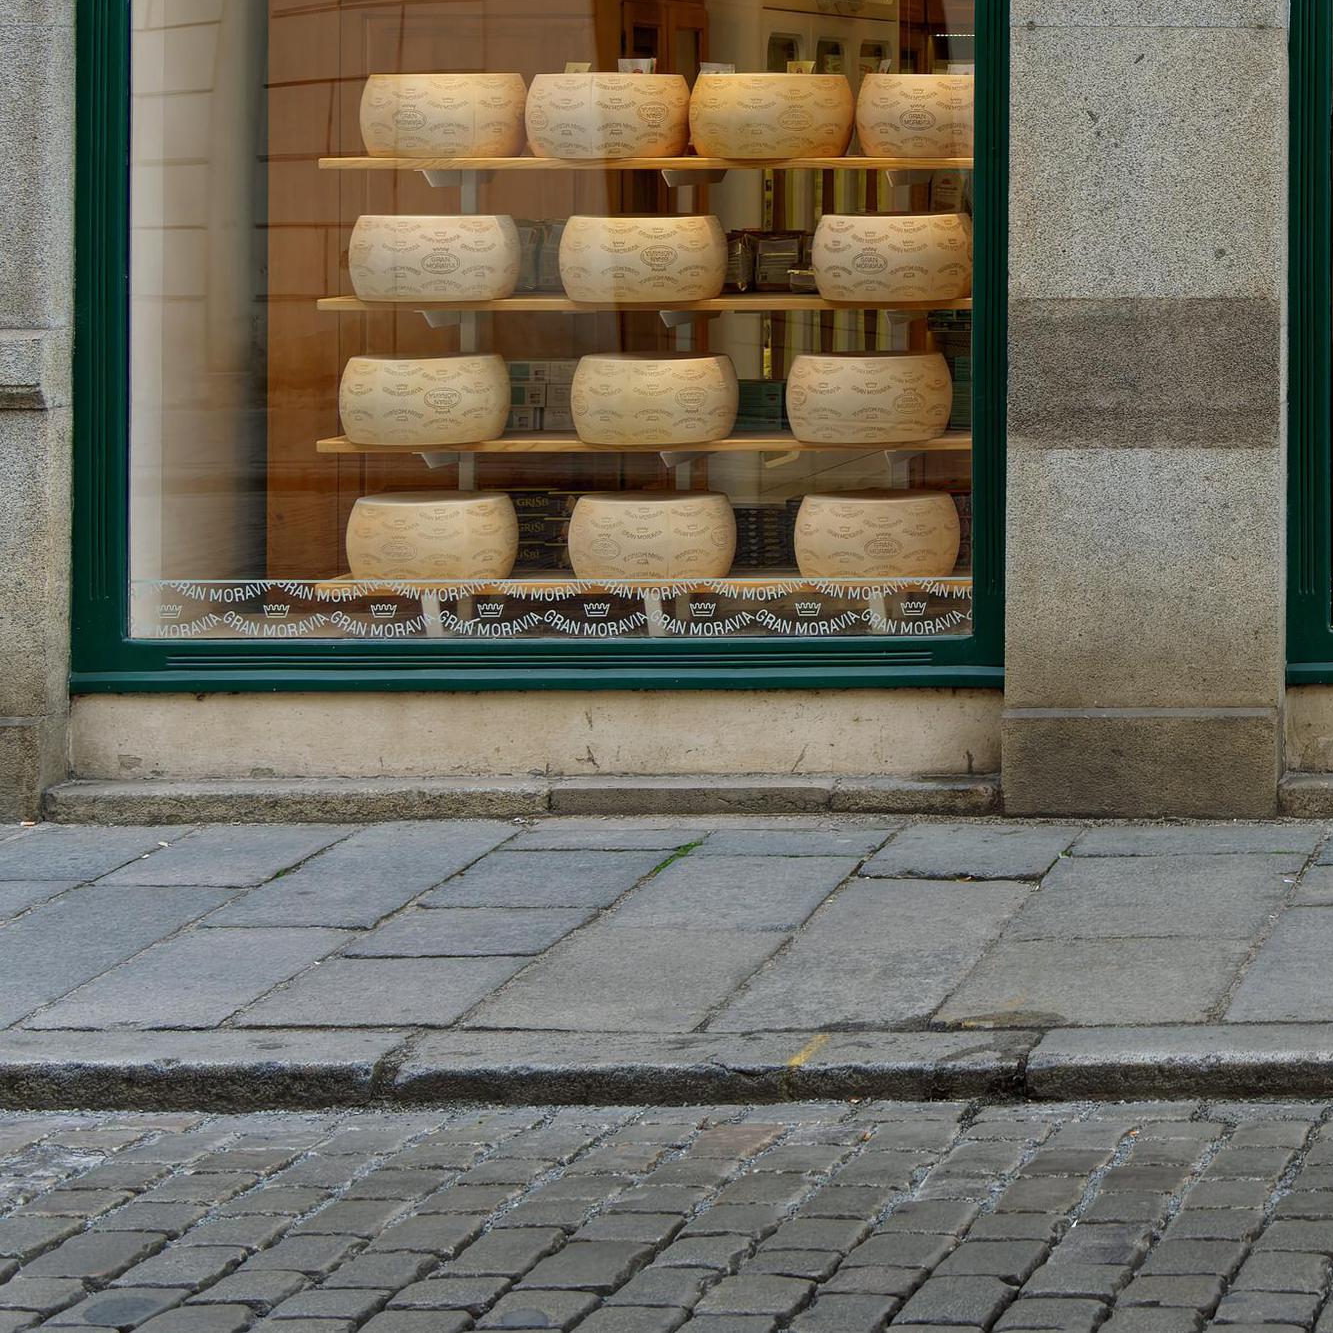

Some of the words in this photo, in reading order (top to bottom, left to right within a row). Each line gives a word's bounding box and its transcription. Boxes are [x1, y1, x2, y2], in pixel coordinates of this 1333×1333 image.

[155, 611, 223, 637] MORAVIA
[223, 611, 259, 636] GRAN
[263, 611, 329, 637] MORAVIA
[330, 611, 367, 636] GRAN
[370, 610, 435, 636] MORAVIA
[439, 610, 473, 635] GRAN
[477, 610, 543, 636] MORAVIA
[543, 610, 580, 635] GRAN
[583, 610, 648, 636] MORAVIA
[650, 610, 685, 635] GRAN
[689, 610, 755, 636] MORAVIA
[755, 609, 791, 634] GRAN
[795, 609, 860, 635] MORAVIA
[861, 609, 896, 634] GRAN
[900, 609, 966, 635] MORAVIA
